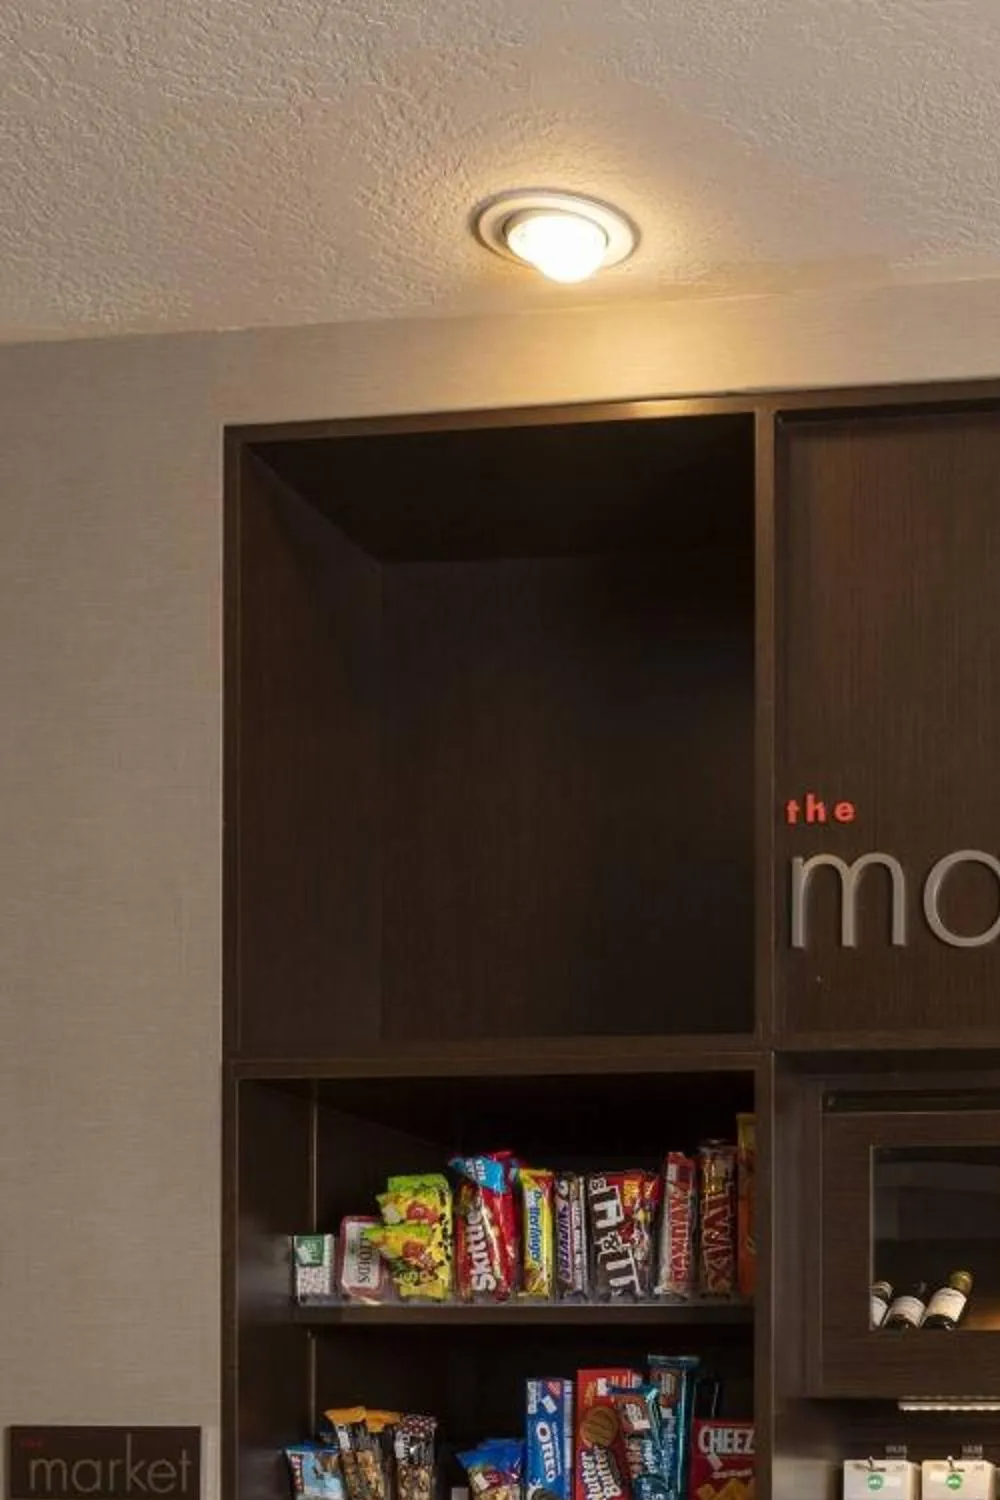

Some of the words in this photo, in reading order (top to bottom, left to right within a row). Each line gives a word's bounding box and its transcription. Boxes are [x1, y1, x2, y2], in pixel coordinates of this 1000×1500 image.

[785, 793, 856, 824] the
[536, 1421, 556, 1483] OREO
[698, 1426, 756, 1454] CHEEZ
[29, 1433, 192, 1493] market
